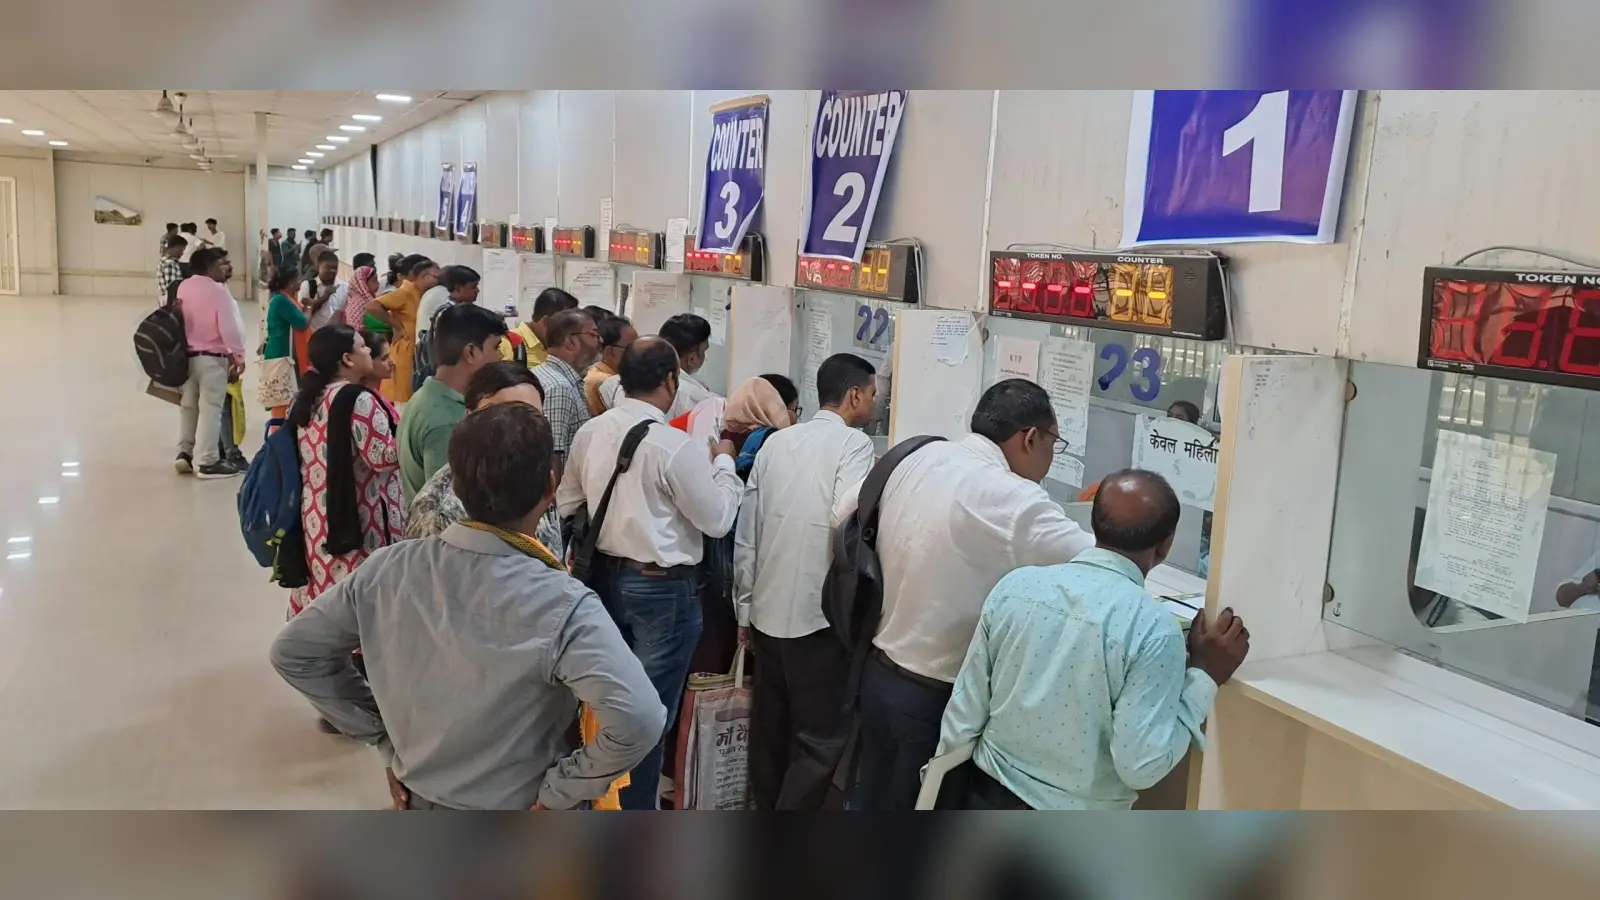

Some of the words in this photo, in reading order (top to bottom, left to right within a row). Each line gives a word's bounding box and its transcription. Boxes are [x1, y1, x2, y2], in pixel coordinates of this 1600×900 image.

[711, 117, 763, 171] COUNTER
[816, 91, 905, 158] COUNTER
[1222, 90, 1289, 212] 1
[714, 181, 740, 239] 3
[822, 171, 866, 243] 2
[1117, 256, 1164, 265] COUNTER
[1515, 273, 1577, 284] TOKEN
[856, 304, 889, 344] 22
[1097, 343, 1161, 402] 23
[1149, 429, 1178, 454] केवल
